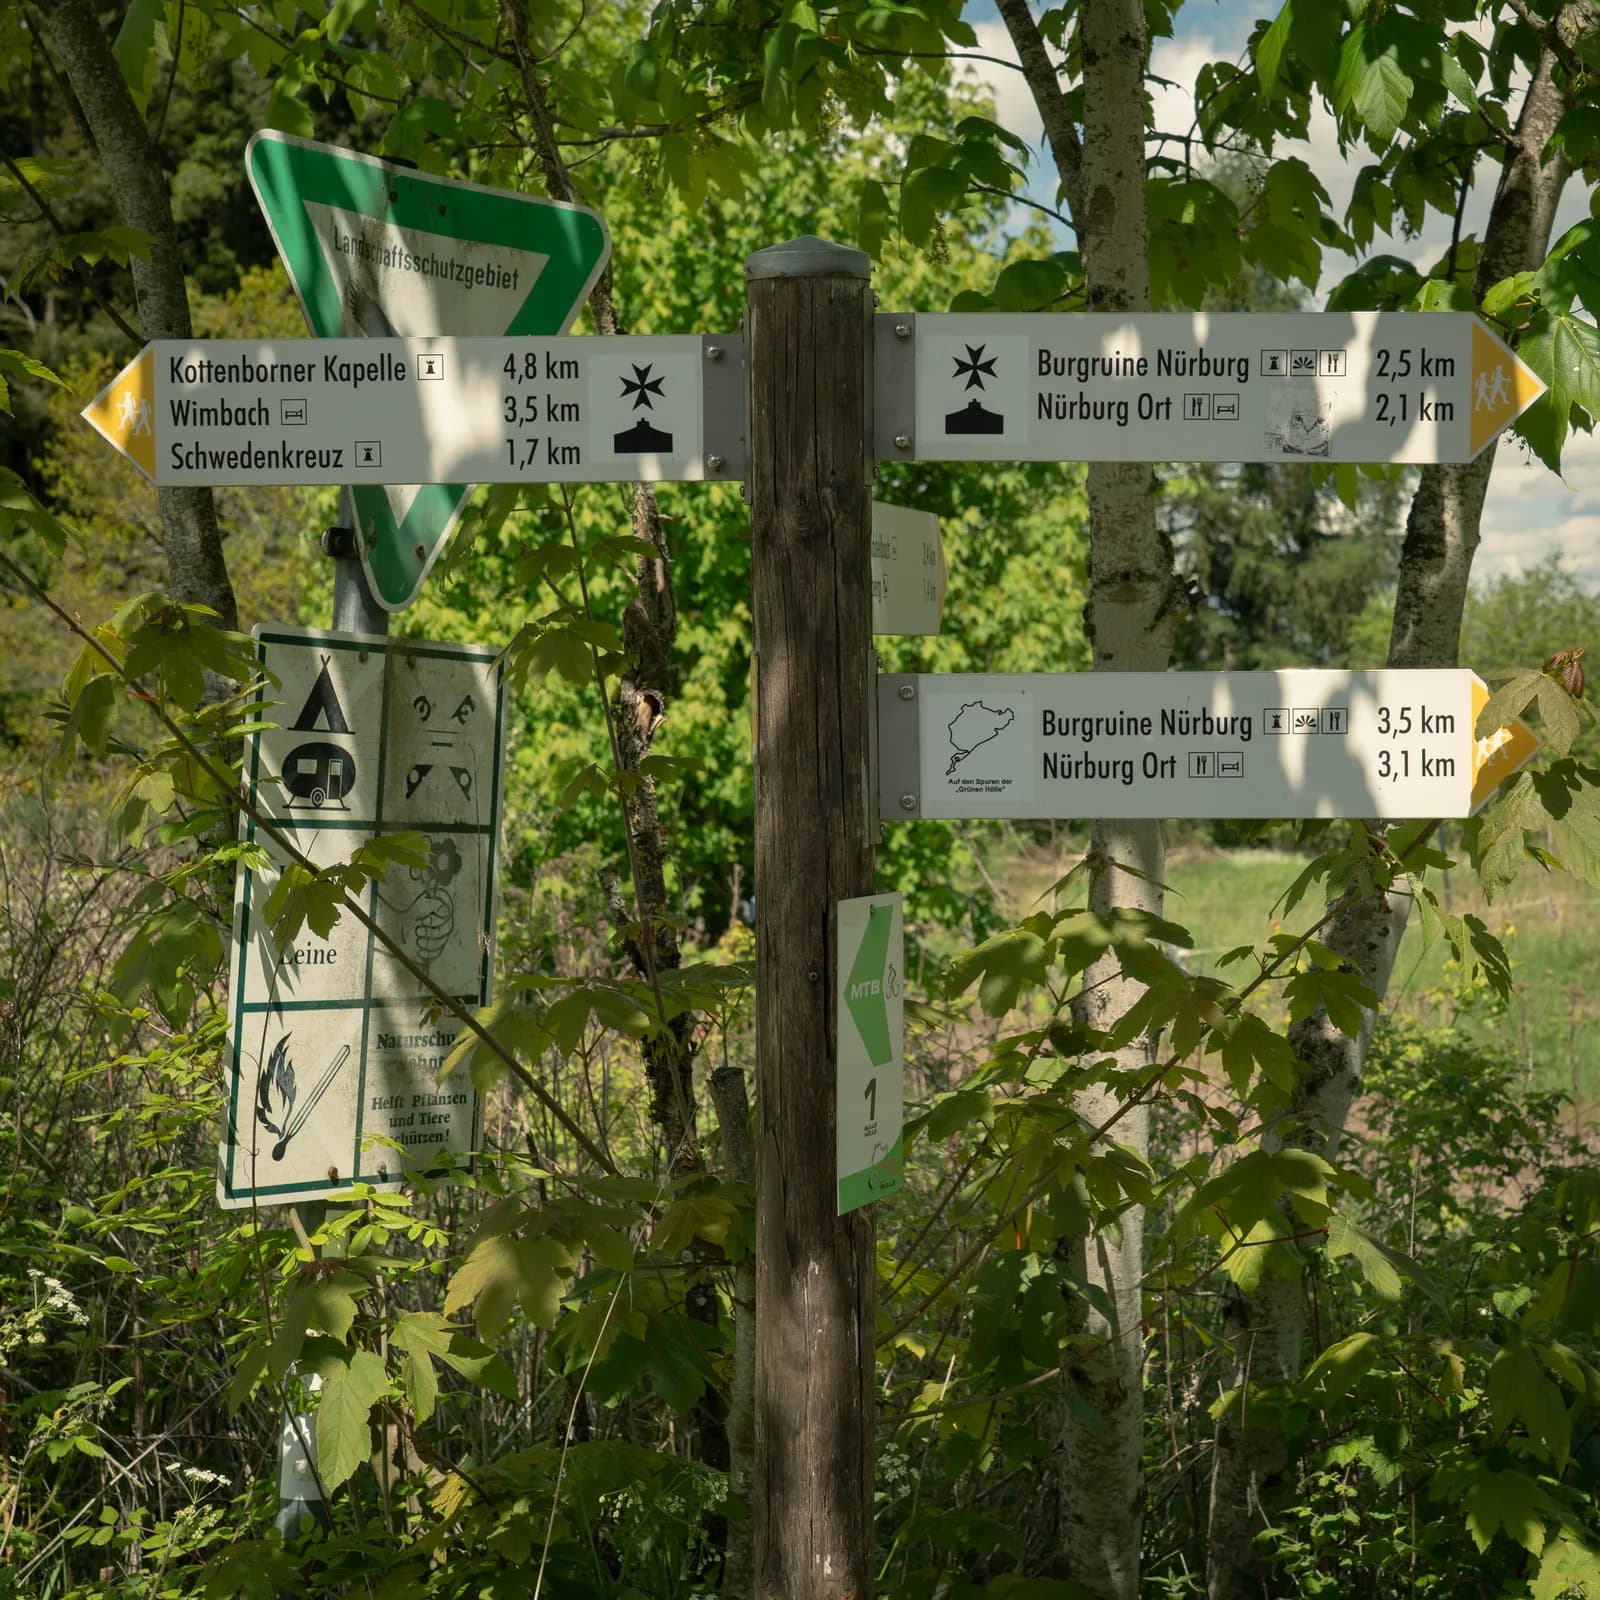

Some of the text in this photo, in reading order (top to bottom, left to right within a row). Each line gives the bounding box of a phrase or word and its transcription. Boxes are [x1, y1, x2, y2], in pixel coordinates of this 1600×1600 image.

[333, 226, 519, 290] Landschaftsschutzgebiet
[170, 350, 579, 388] Kottenborner Kapelle 4,8 km
[1038, 347, 1455, 383] Burgruine Nürburg 2,5 km
[170, 393, 580, 428] Wimbach 3,5 km
[1037, 391, 1454, 427] Nürburg Ort 2,1 km
[171, 436, 581, 471] Schwedenkreuz 1,7 km
[1042, 704, 1455, 743] Burgruine Nürburg 3,5 km
[975, 778, 1000, 786] Spuren
[1043, 748, 1455, 786] Nürburg Ort 3,1 km
[851, 979, 881, 1000] MTB
[371, 1093, 467, 1111] Helft Pflanzen
[863, 1078, 877, 1121] 1
[389, 1112, 451, 1128] und Tiere
